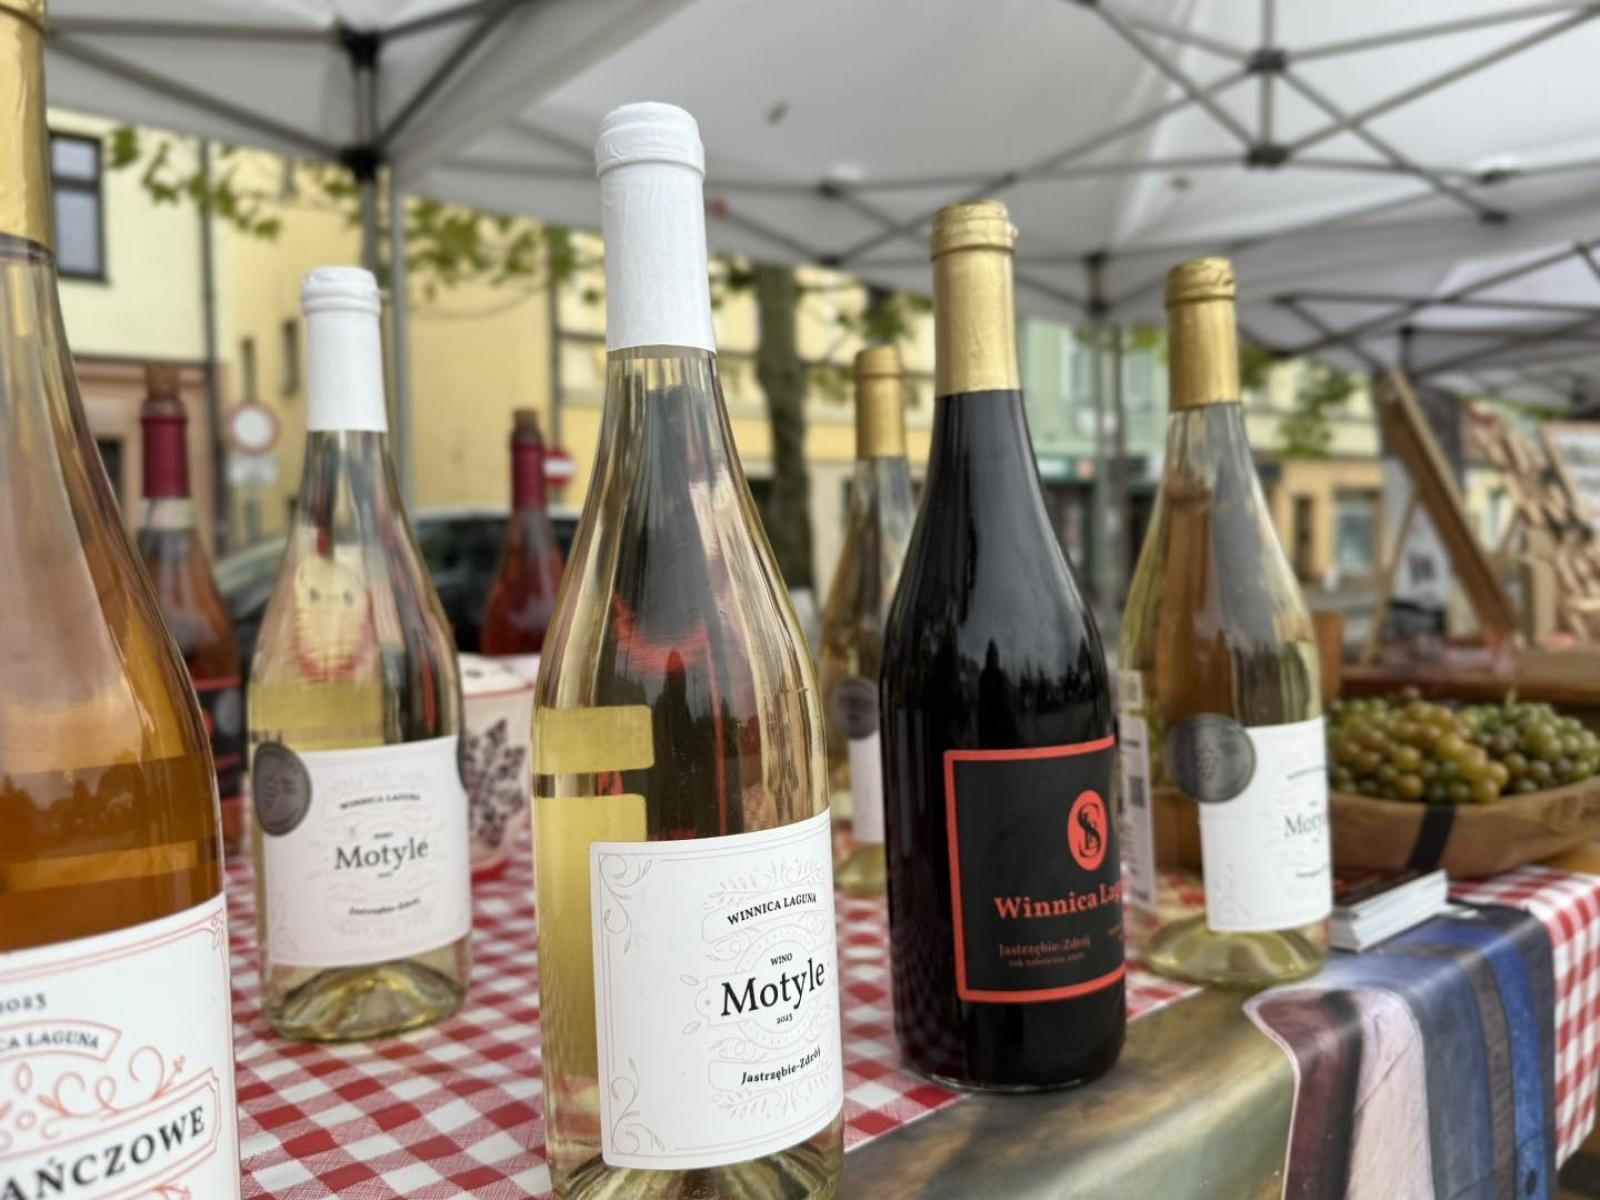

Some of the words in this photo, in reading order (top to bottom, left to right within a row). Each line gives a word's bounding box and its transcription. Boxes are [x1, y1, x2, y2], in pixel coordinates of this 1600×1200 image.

[335, 836, 429, 871] Motyle
[726, 899, 782, 926] WINNICA
[783, 892, 817, 909] LAGUNA
[994, 890, 1098, 919] Winnica
[770, 952, 793, 967] WINO
[721, 956, 826, 1017] Motyle
[26, 1030, 99, 1049] LAGUNA
[740, 1044, 821, 1086] Jastrzębie-Zdrój
